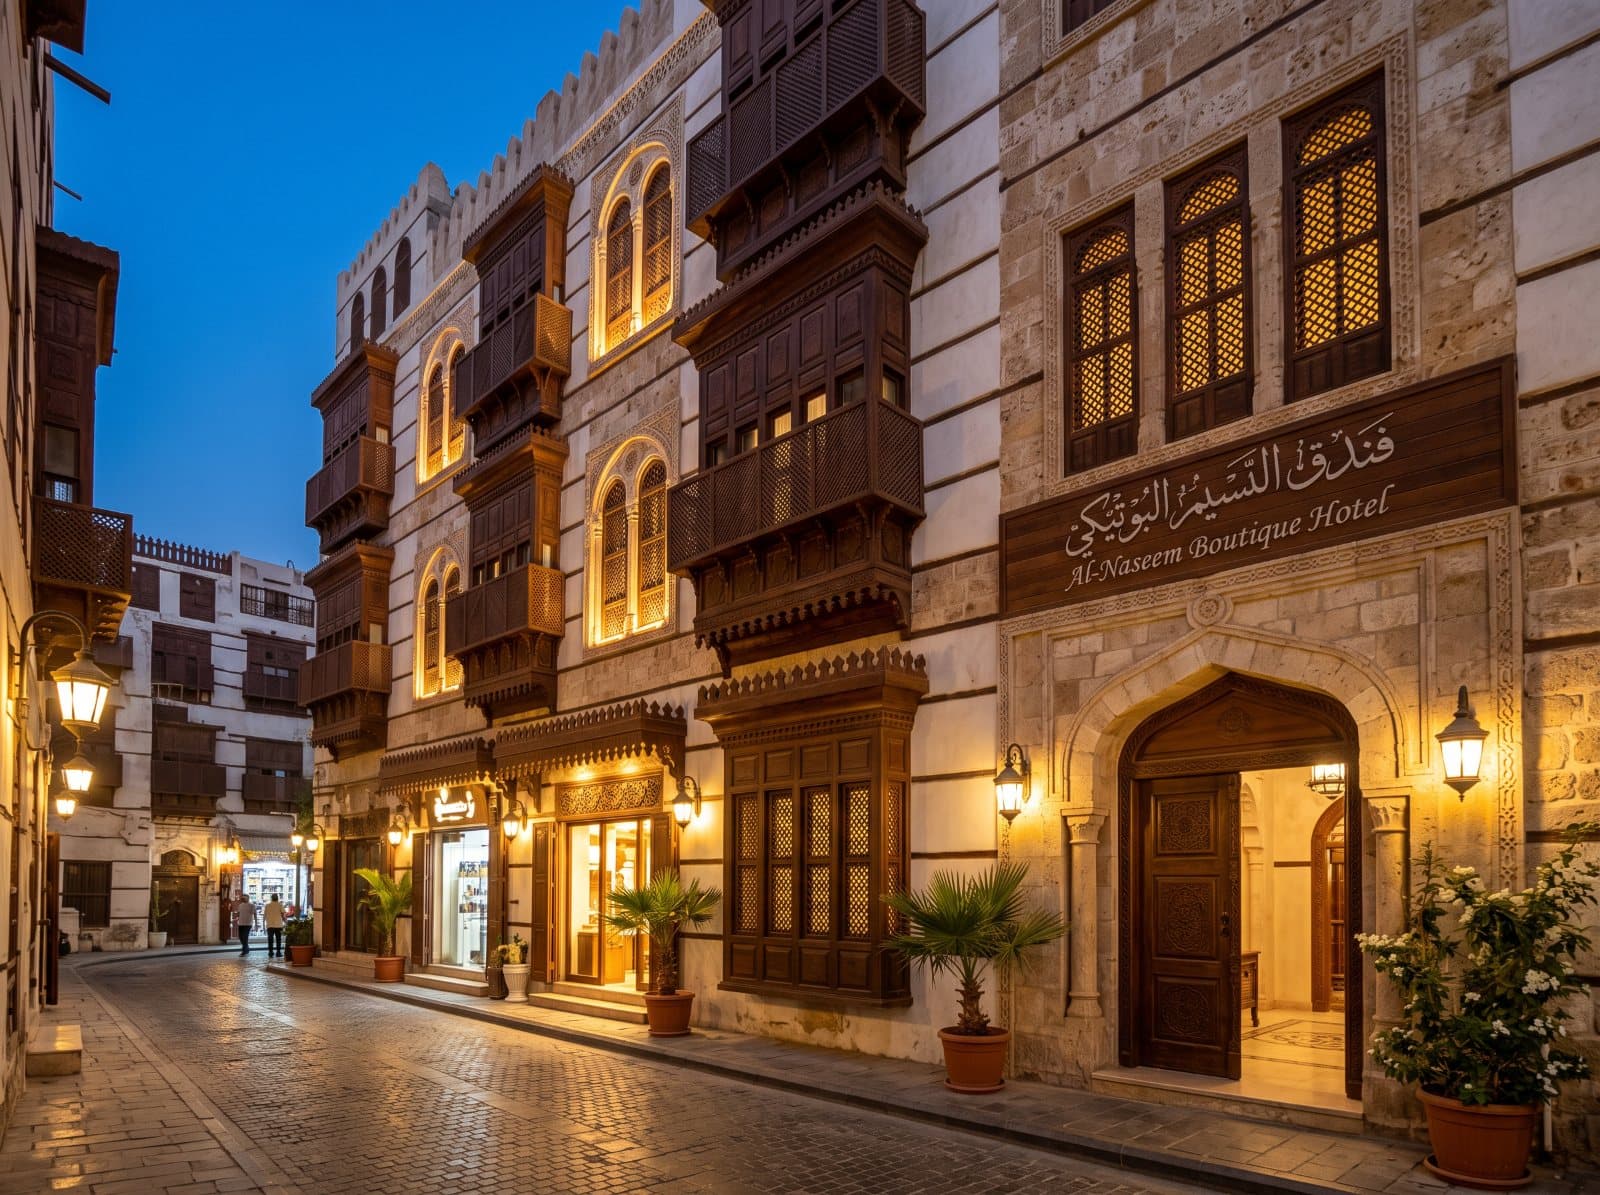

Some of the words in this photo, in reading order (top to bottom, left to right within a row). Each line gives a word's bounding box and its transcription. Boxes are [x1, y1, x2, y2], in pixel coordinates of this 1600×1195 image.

[1063, 546, 1183, 593] Al-Naseem
[1188, 516, 1302, 559] Boutique
[1307, 483, 1396, 532] Hotel
